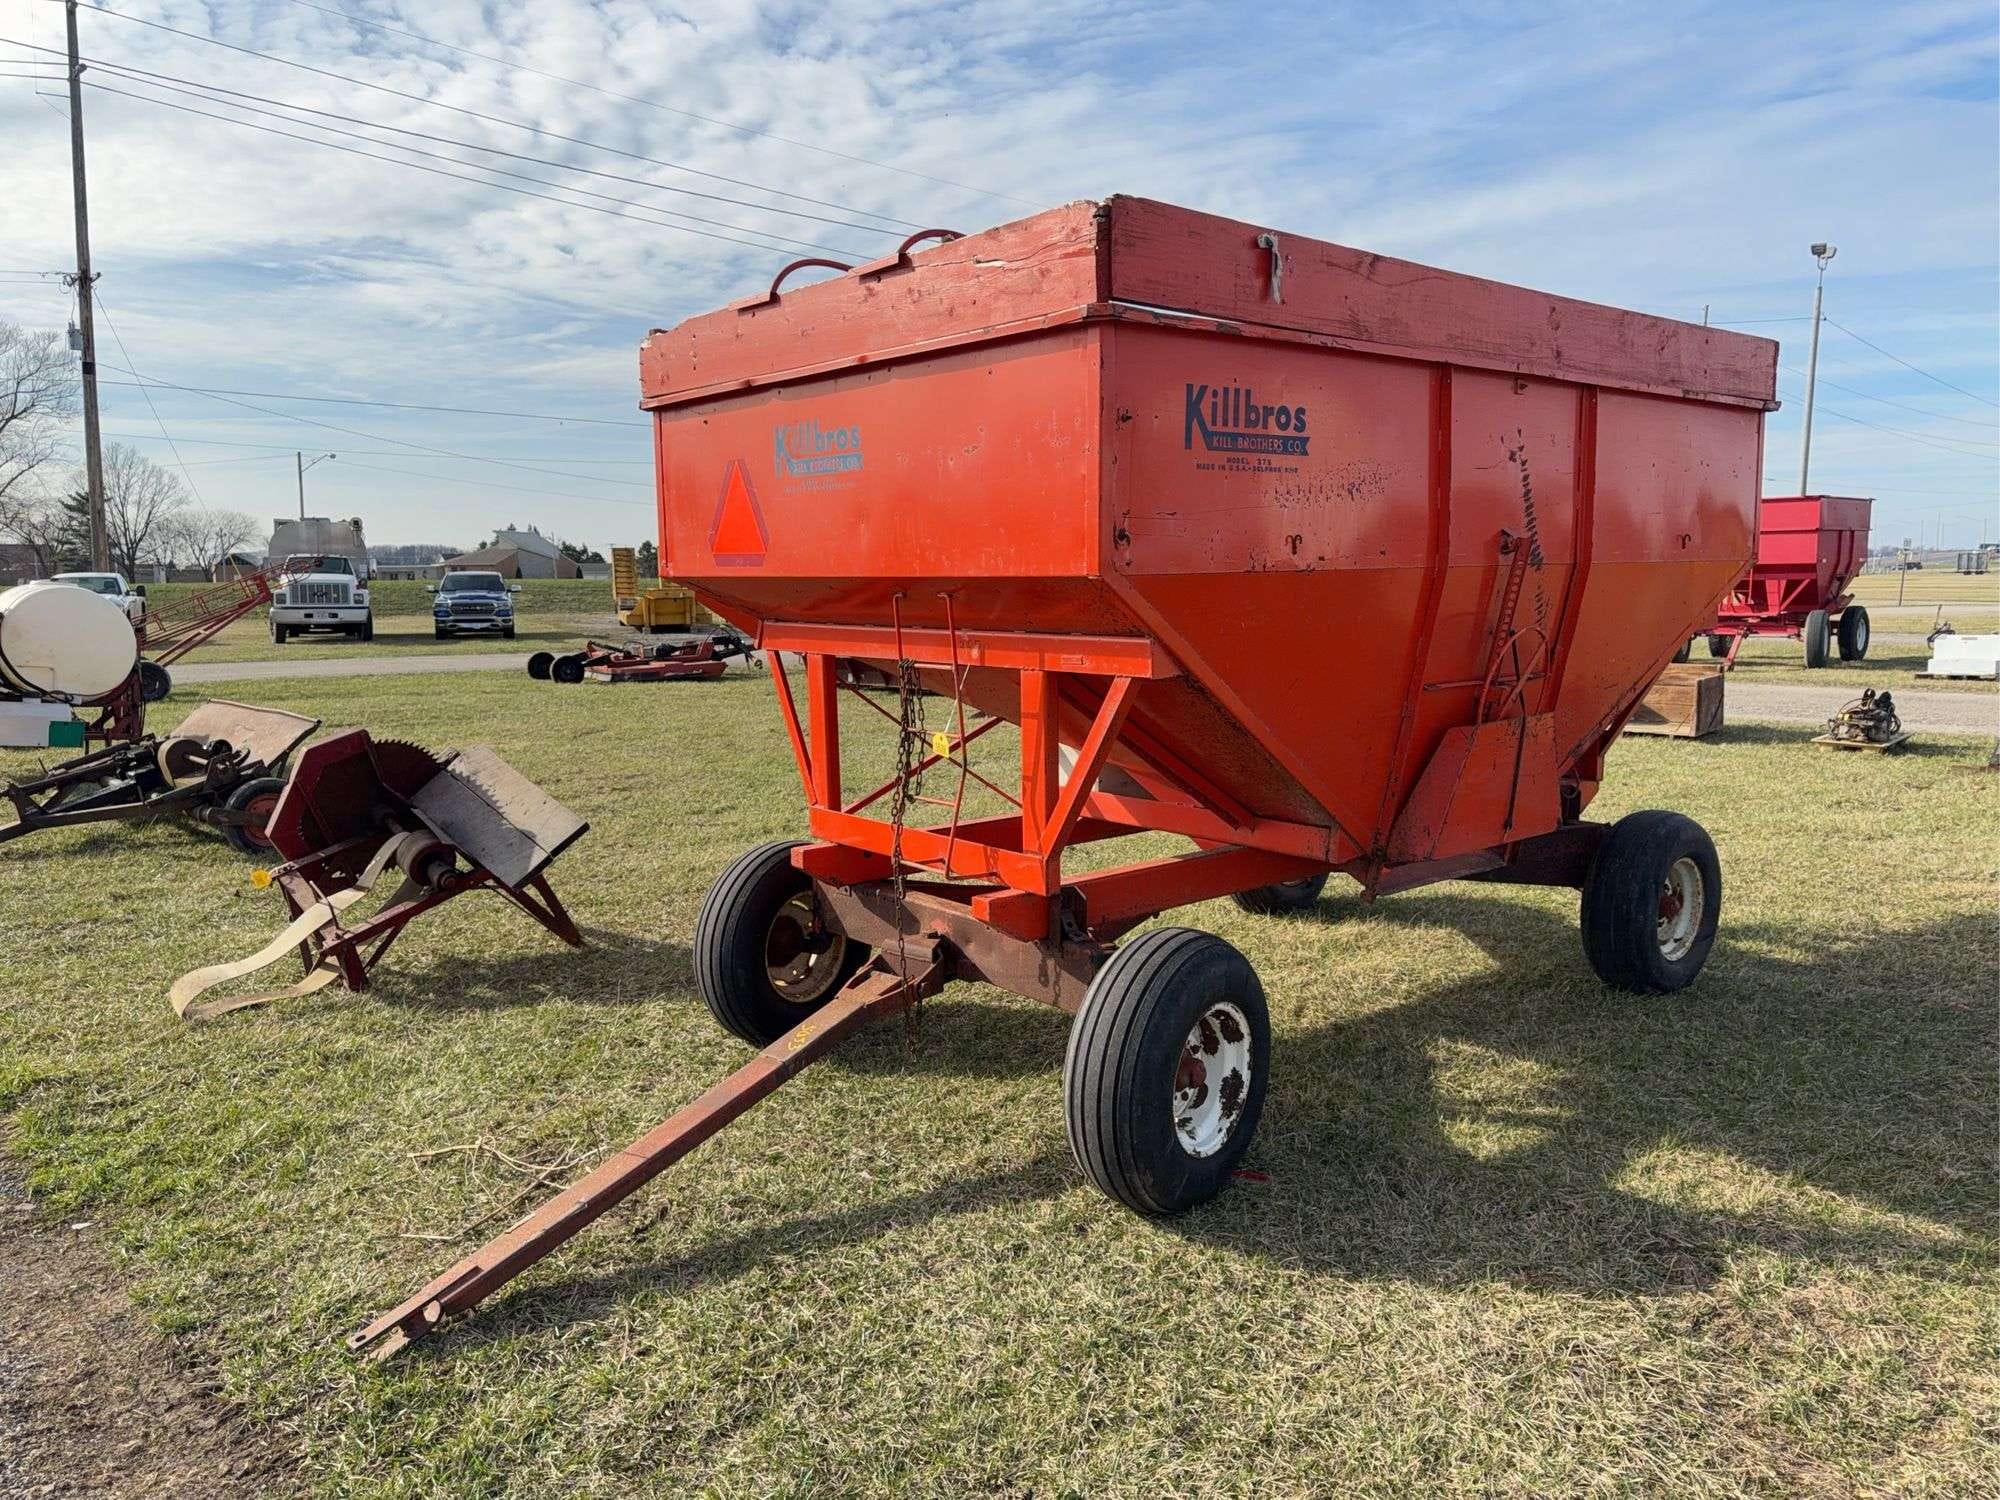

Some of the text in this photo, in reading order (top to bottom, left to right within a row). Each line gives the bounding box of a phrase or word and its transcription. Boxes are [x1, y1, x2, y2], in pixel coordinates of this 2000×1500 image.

[1185, 384, 1307, 450] Killbros
[774, 417, 861, 480] Killbros
[1213, 436, 1304, 453] KILL BROTHERS CO.
[1226, 457, 1249, 465] MODEL
